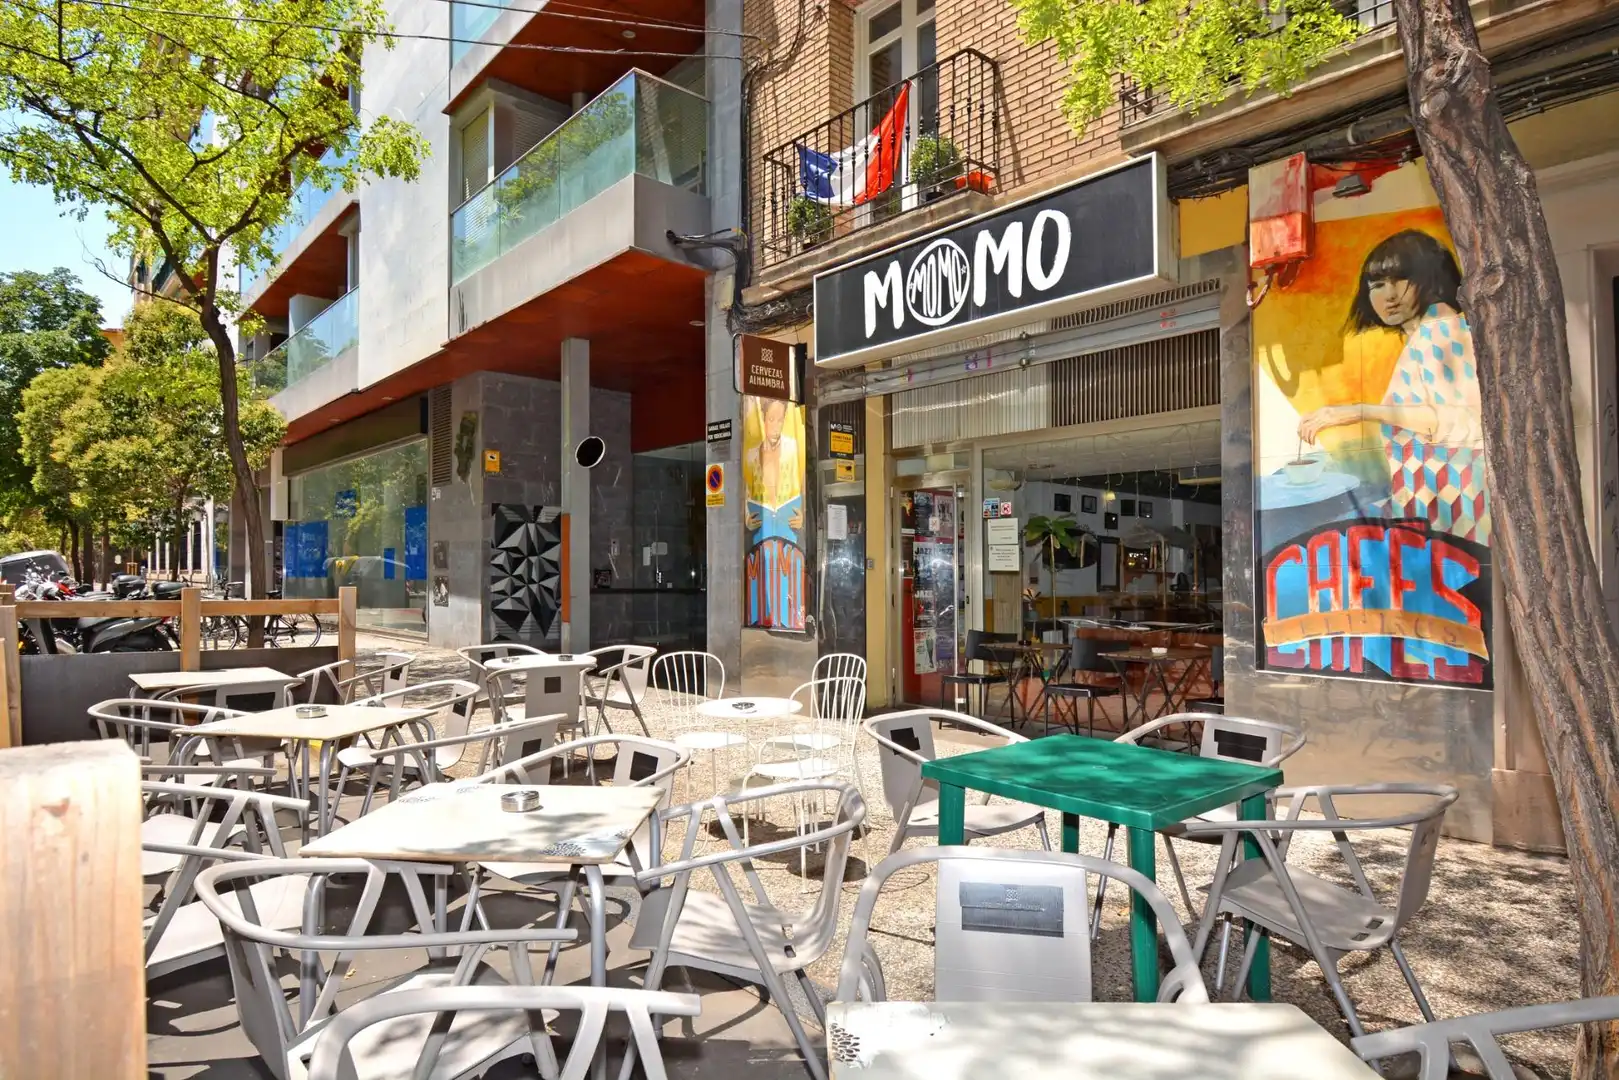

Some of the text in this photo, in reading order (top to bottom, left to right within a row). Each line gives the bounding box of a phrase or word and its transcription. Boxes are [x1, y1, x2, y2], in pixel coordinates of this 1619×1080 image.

[864, 209, 1072, 338] MOMO
[911, 246, 963, 318] MOMO
[749, 375, 785, 390] ALHAMBRA
[751, 365, 783, 379] CERVEZAS
[747, 539, 806, 629] MOMO
